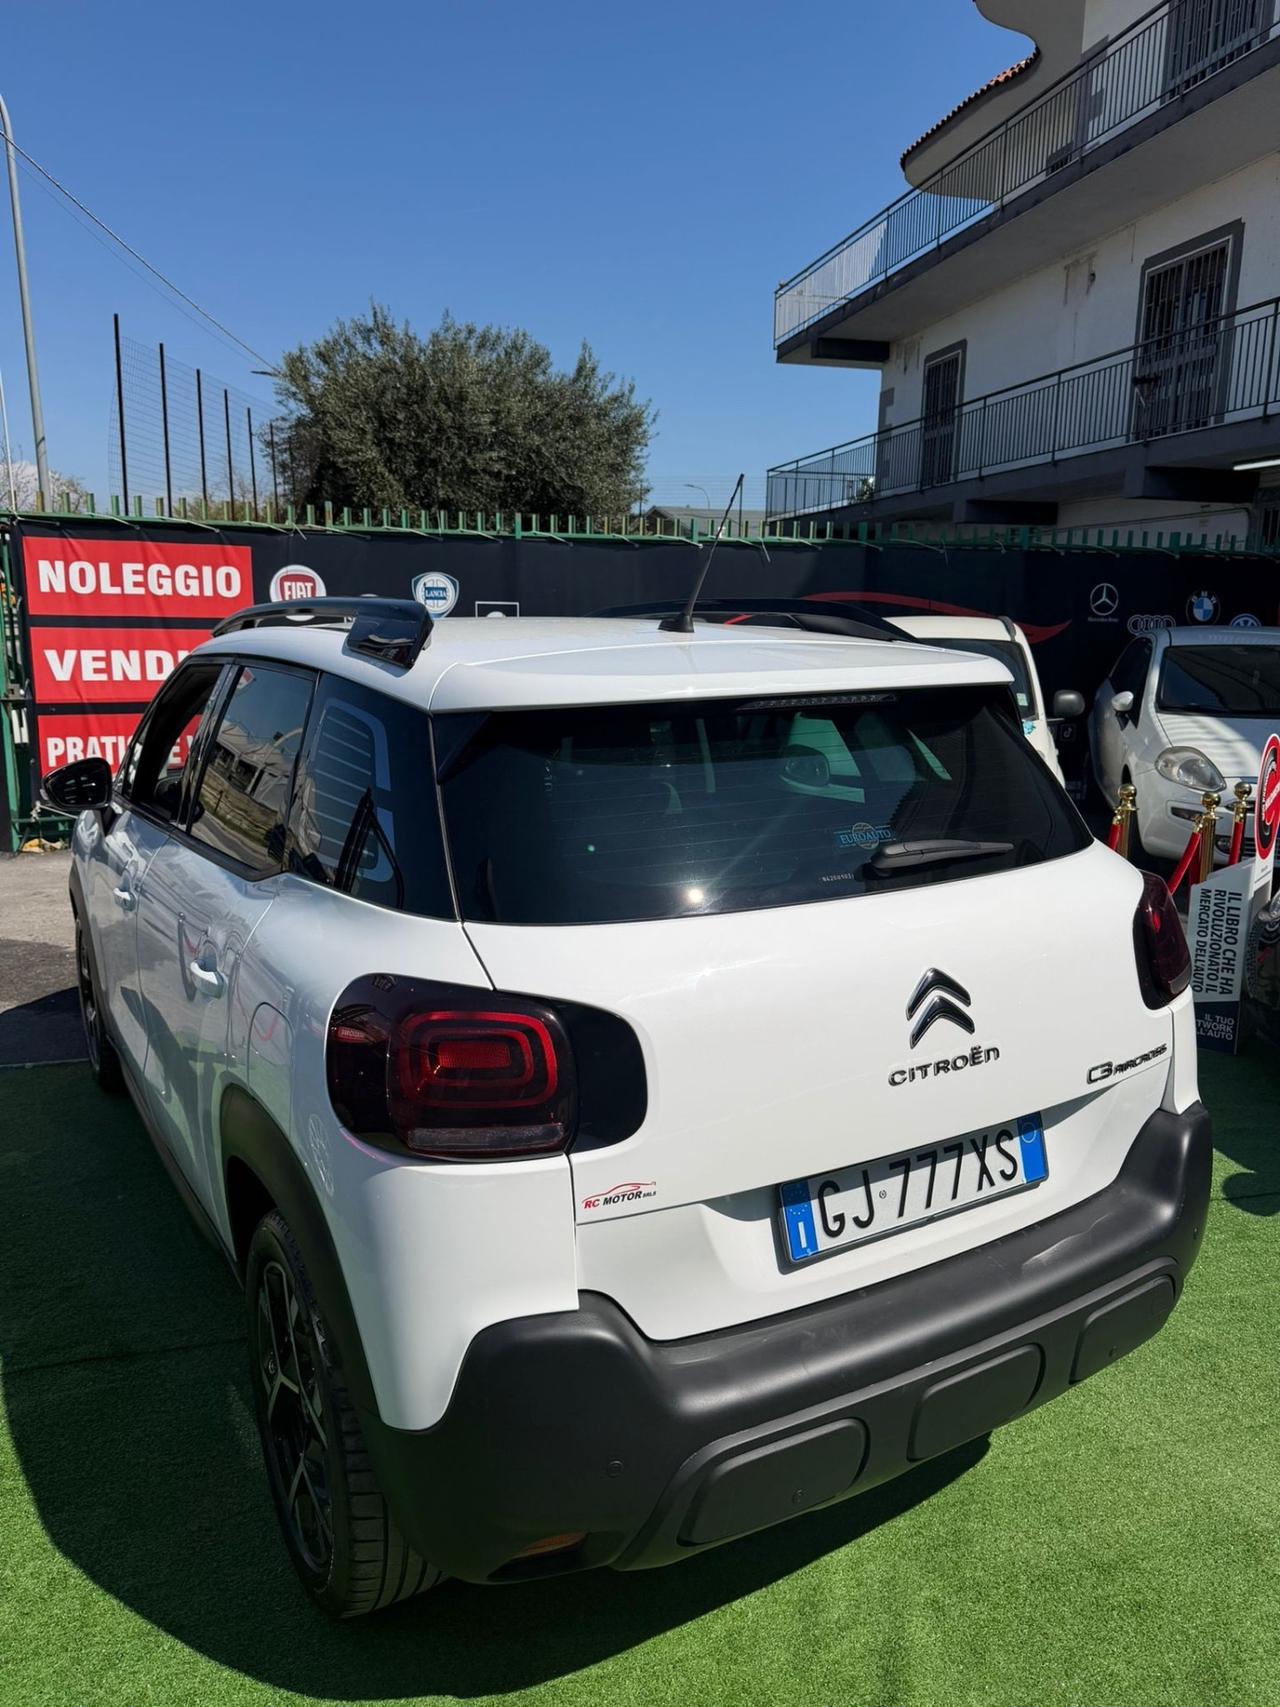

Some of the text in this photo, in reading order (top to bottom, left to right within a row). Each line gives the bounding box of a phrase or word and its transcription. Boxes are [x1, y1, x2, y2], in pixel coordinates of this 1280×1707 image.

[38, 560, 242, 598] NOLEGGIO
[284, 581, 314, 600] FIAT
[839, 829, 891, 844] EUROAUTO
[1192, 888, 1212, 993] MERCATO DELL'AUTO
[1205, 889, 1227, 993] RIVOLUZIONATO IL
[1219, 891, 1242, 995] IL LIBRO CHE HA
[1196, 1019, 1233, 1033] TWORK
[1204, 1013, 1235, 1025] IL TUO
[1086, 1061, 1113, 1085] C3
[583, 1199, 601, 1209] RC
[603, 1191, 642, 1206] MOTOR
